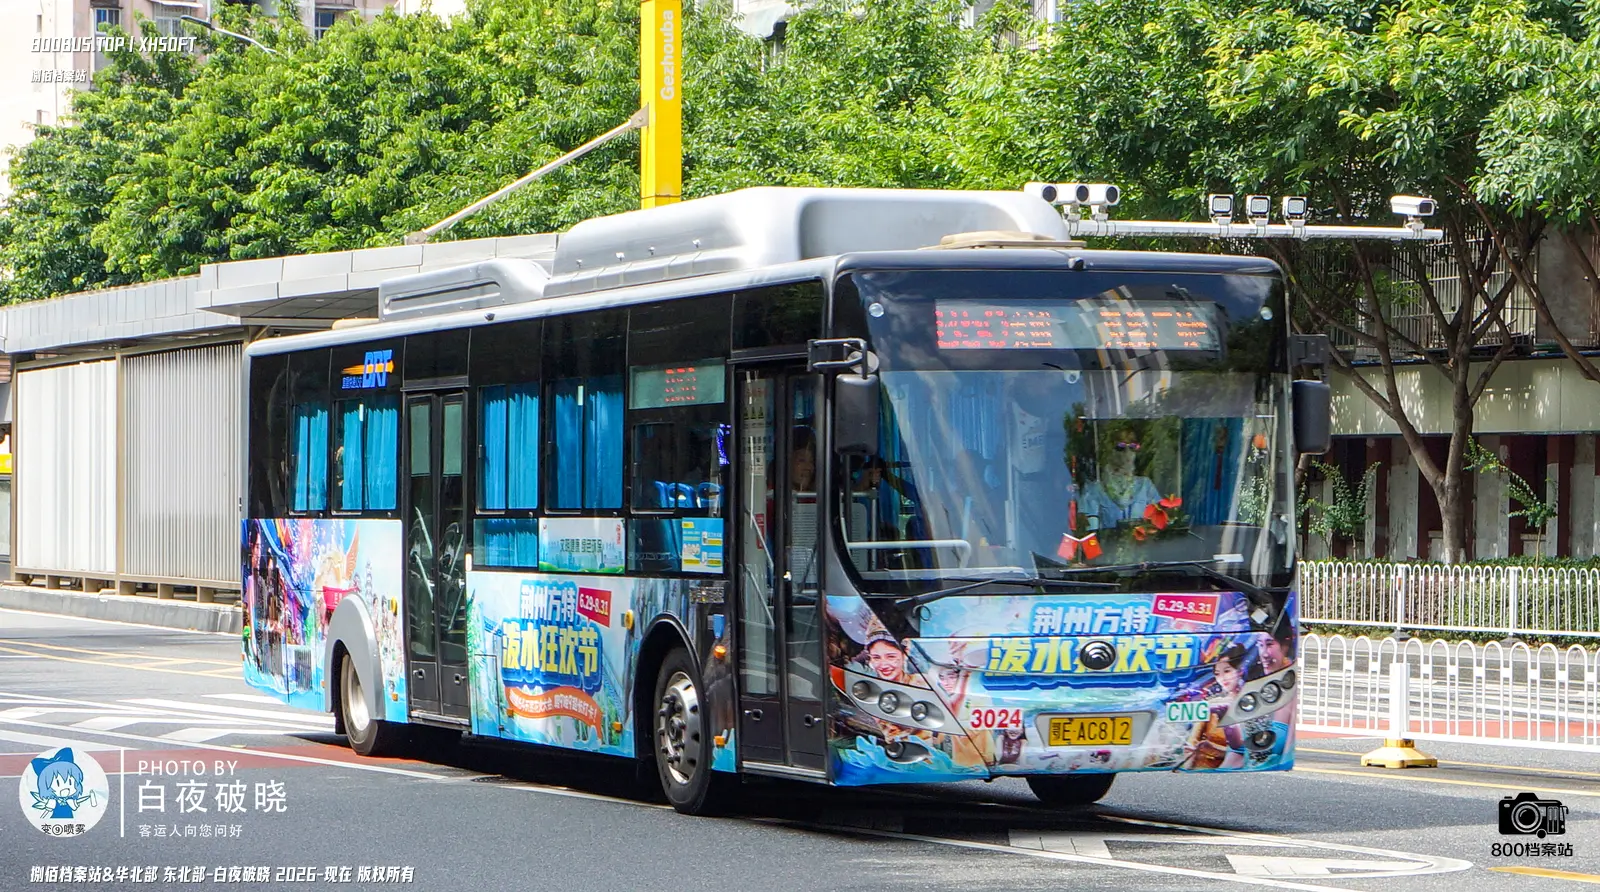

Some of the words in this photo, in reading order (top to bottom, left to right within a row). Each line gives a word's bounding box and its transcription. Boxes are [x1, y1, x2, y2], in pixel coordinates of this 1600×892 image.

[660, 9, 675, 101] Gezhouba
[521, 585, 575, 622] 荆州方特
[579, 593, 610, 616] 6.29-8.31
[1157, 599, 1213, 615] 6.29-8.31
[1034, 606, 1150, 635] 荆州方特
[502, 622, 598, 677] 泼水狂欢节
[986, 636, 1193, 676] 泼水欢节
[971, 709, 1022, 729] 3024
[1168, 702, 1209, 722] CNG
